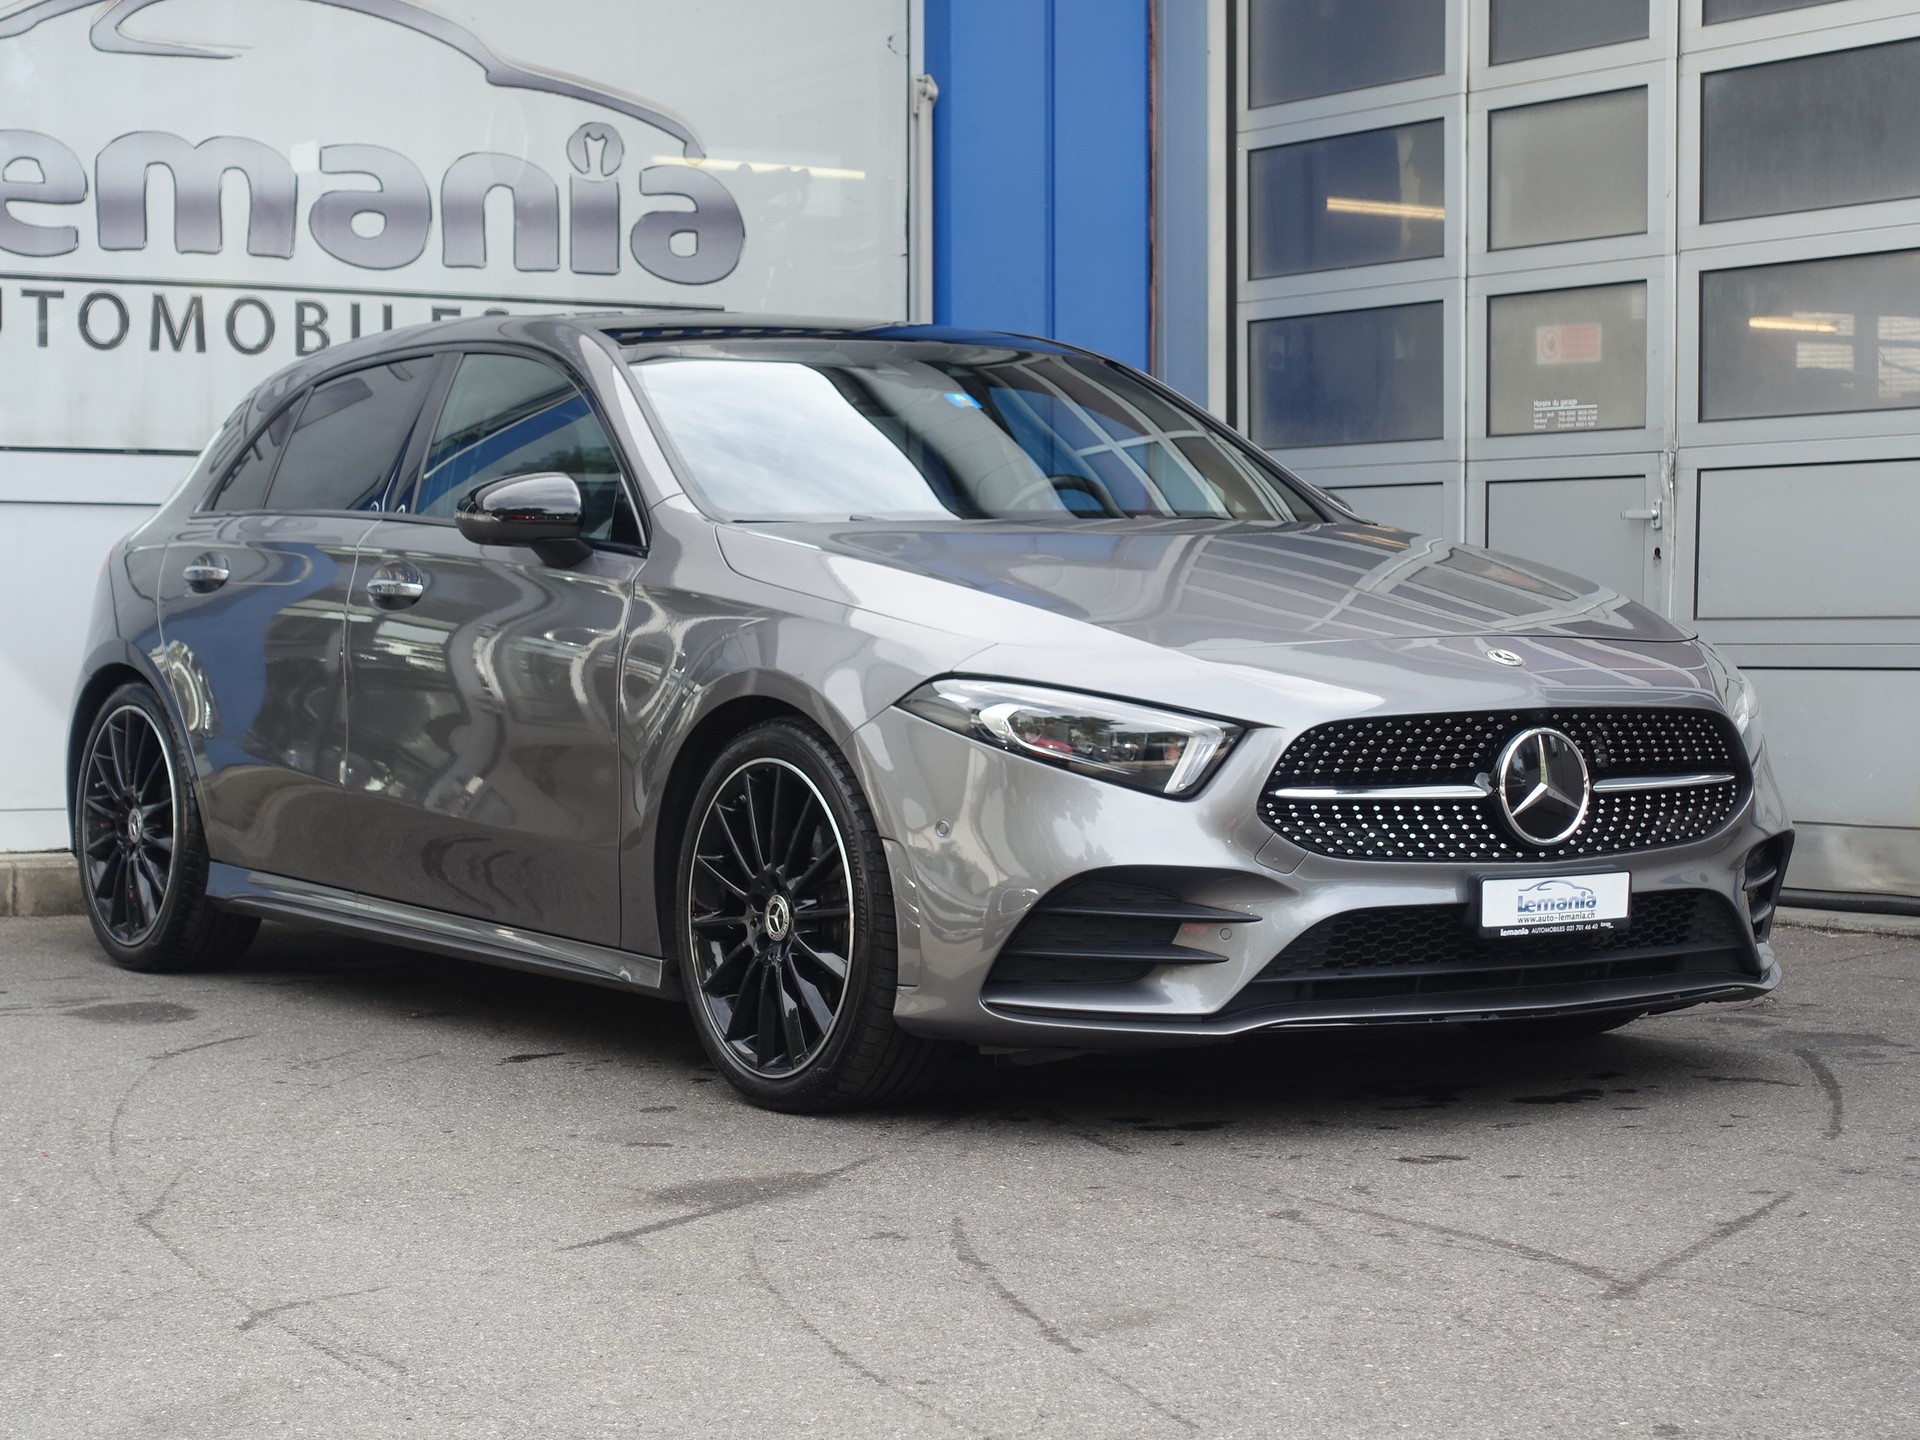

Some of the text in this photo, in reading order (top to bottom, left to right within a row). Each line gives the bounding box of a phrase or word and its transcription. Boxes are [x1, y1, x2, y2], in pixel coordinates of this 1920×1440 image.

[1517, 891, 1597, 913] Lemania
[1517, 911, 1596, 924] www.auto-lemania.ch
[1531, 925, 1566, 934] AUTOMOBILES
[1566, 924, 1575, 932] 021
